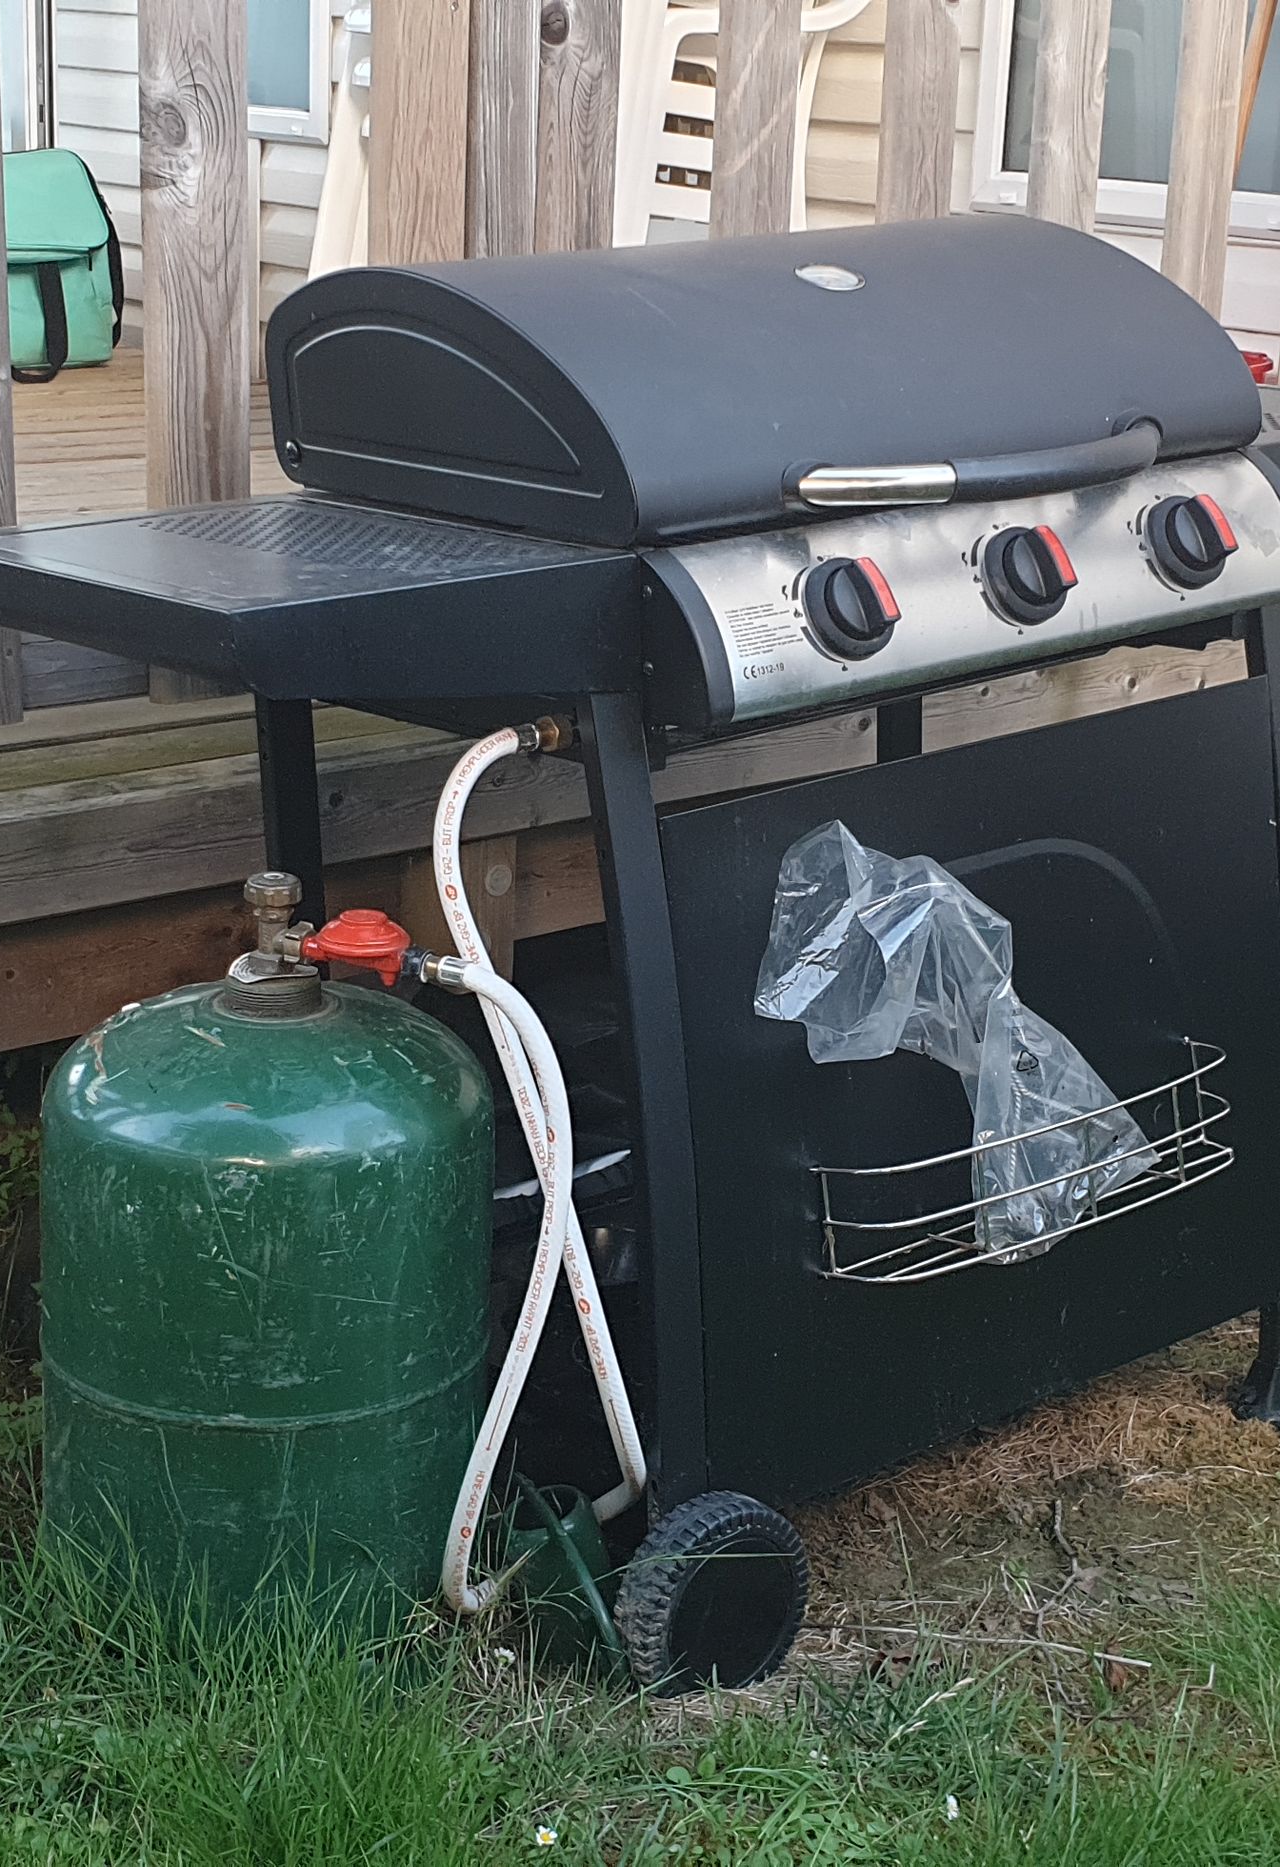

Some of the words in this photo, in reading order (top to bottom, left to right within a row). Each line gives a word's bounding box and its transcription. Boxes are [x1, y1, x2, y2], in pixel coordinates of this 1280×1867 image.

[443, 801, 456, 826] PROP
[442, 827, 453, 846] BUT
[442, 857, 453, 875] GAZ
[517, 1086, 532, 1110] 2031
[545, 1200, 554, 1225] PROP
[530, 1248, 549, 1301] REMPLACER
[571, 1270, 584, 1290] GAZ
[523, 1301, 538, 1331] AVANT
[516, 1330, 530, 1353] 2031
